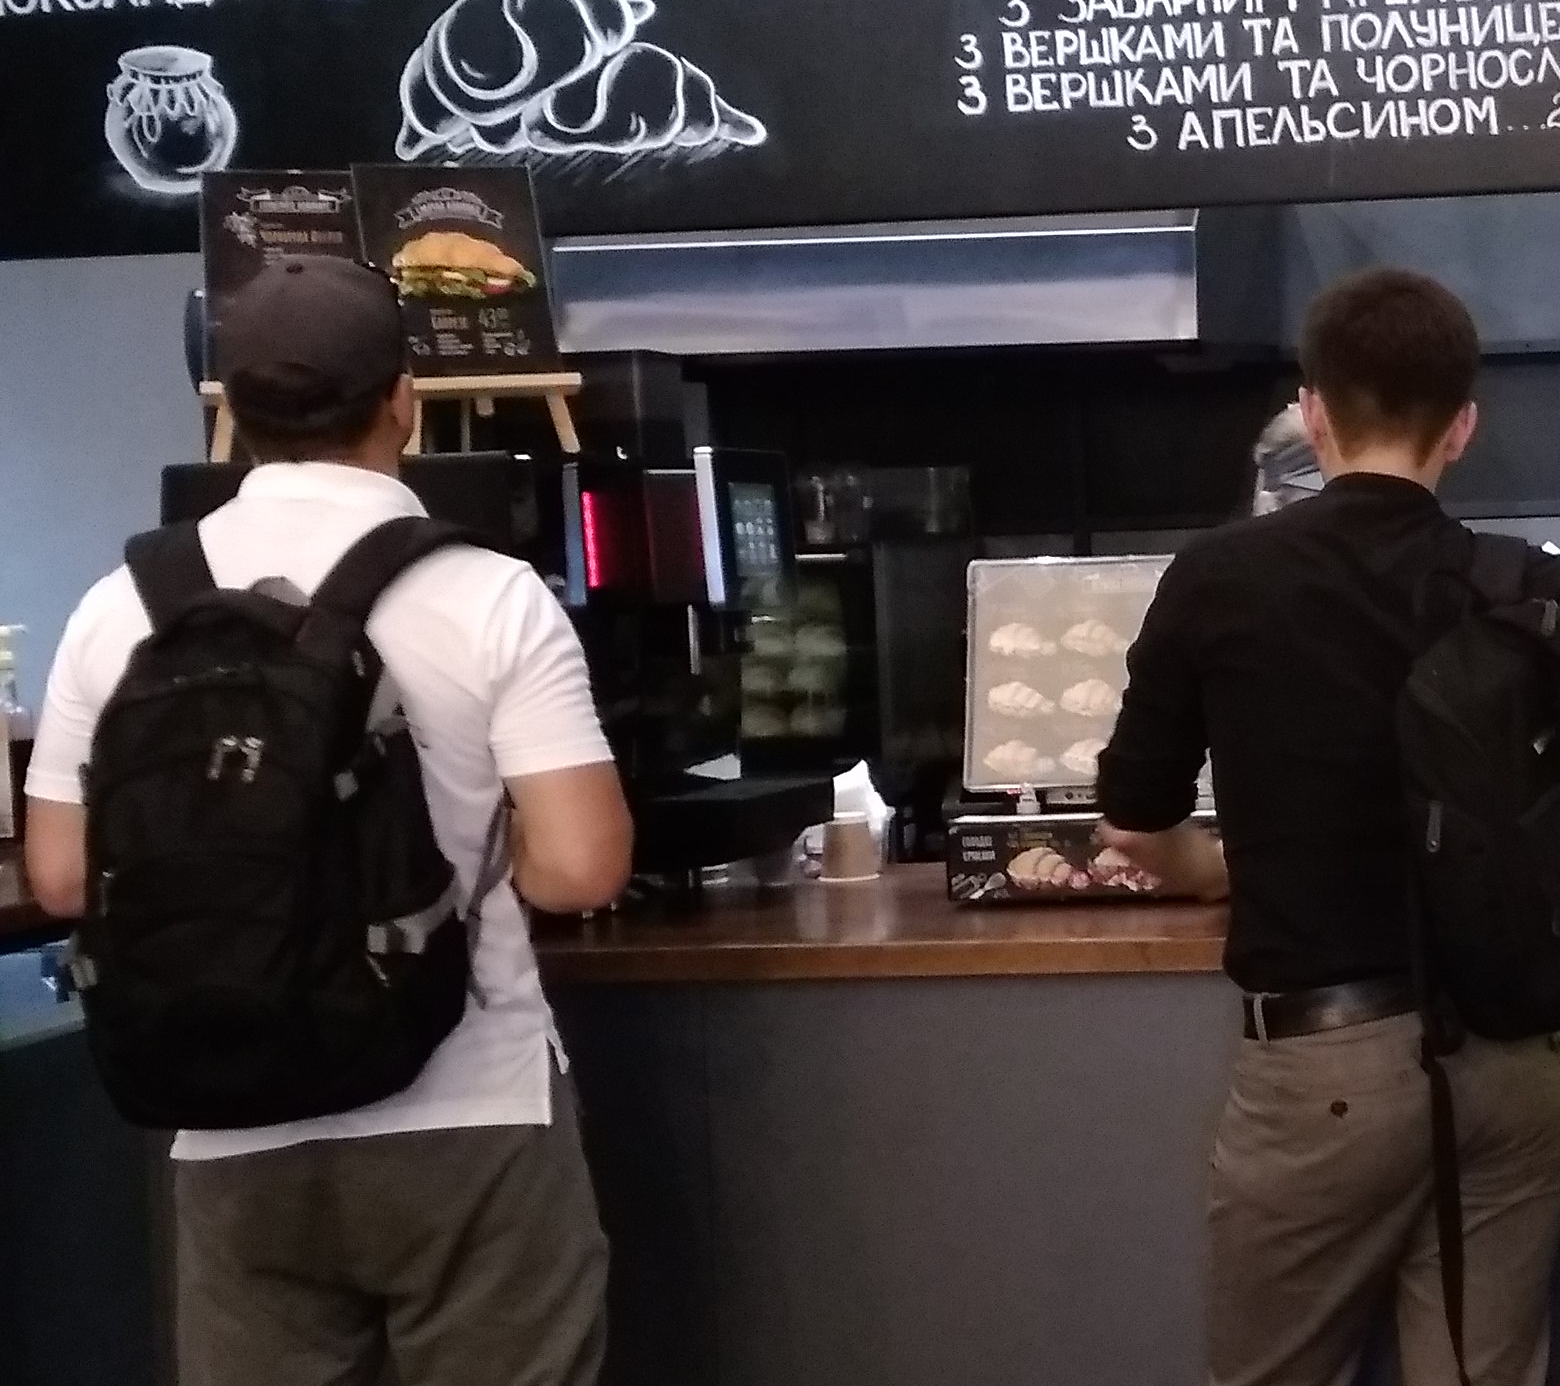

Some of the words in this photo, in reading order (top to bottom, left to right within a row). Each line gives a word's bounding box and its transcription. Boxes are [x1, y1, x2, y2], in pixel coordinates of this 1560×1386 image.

[1001, 21, 1225, 69] ВЕРШКАМИ
[1242, 17, 1299, 56] ТА
[1004, 63, 1253, 113] ВЕРШКАМИ
[1277, 59, 1339, 99] ТА
[1178, 96, 1500, 151] АПЕЛЬСИНОМ
